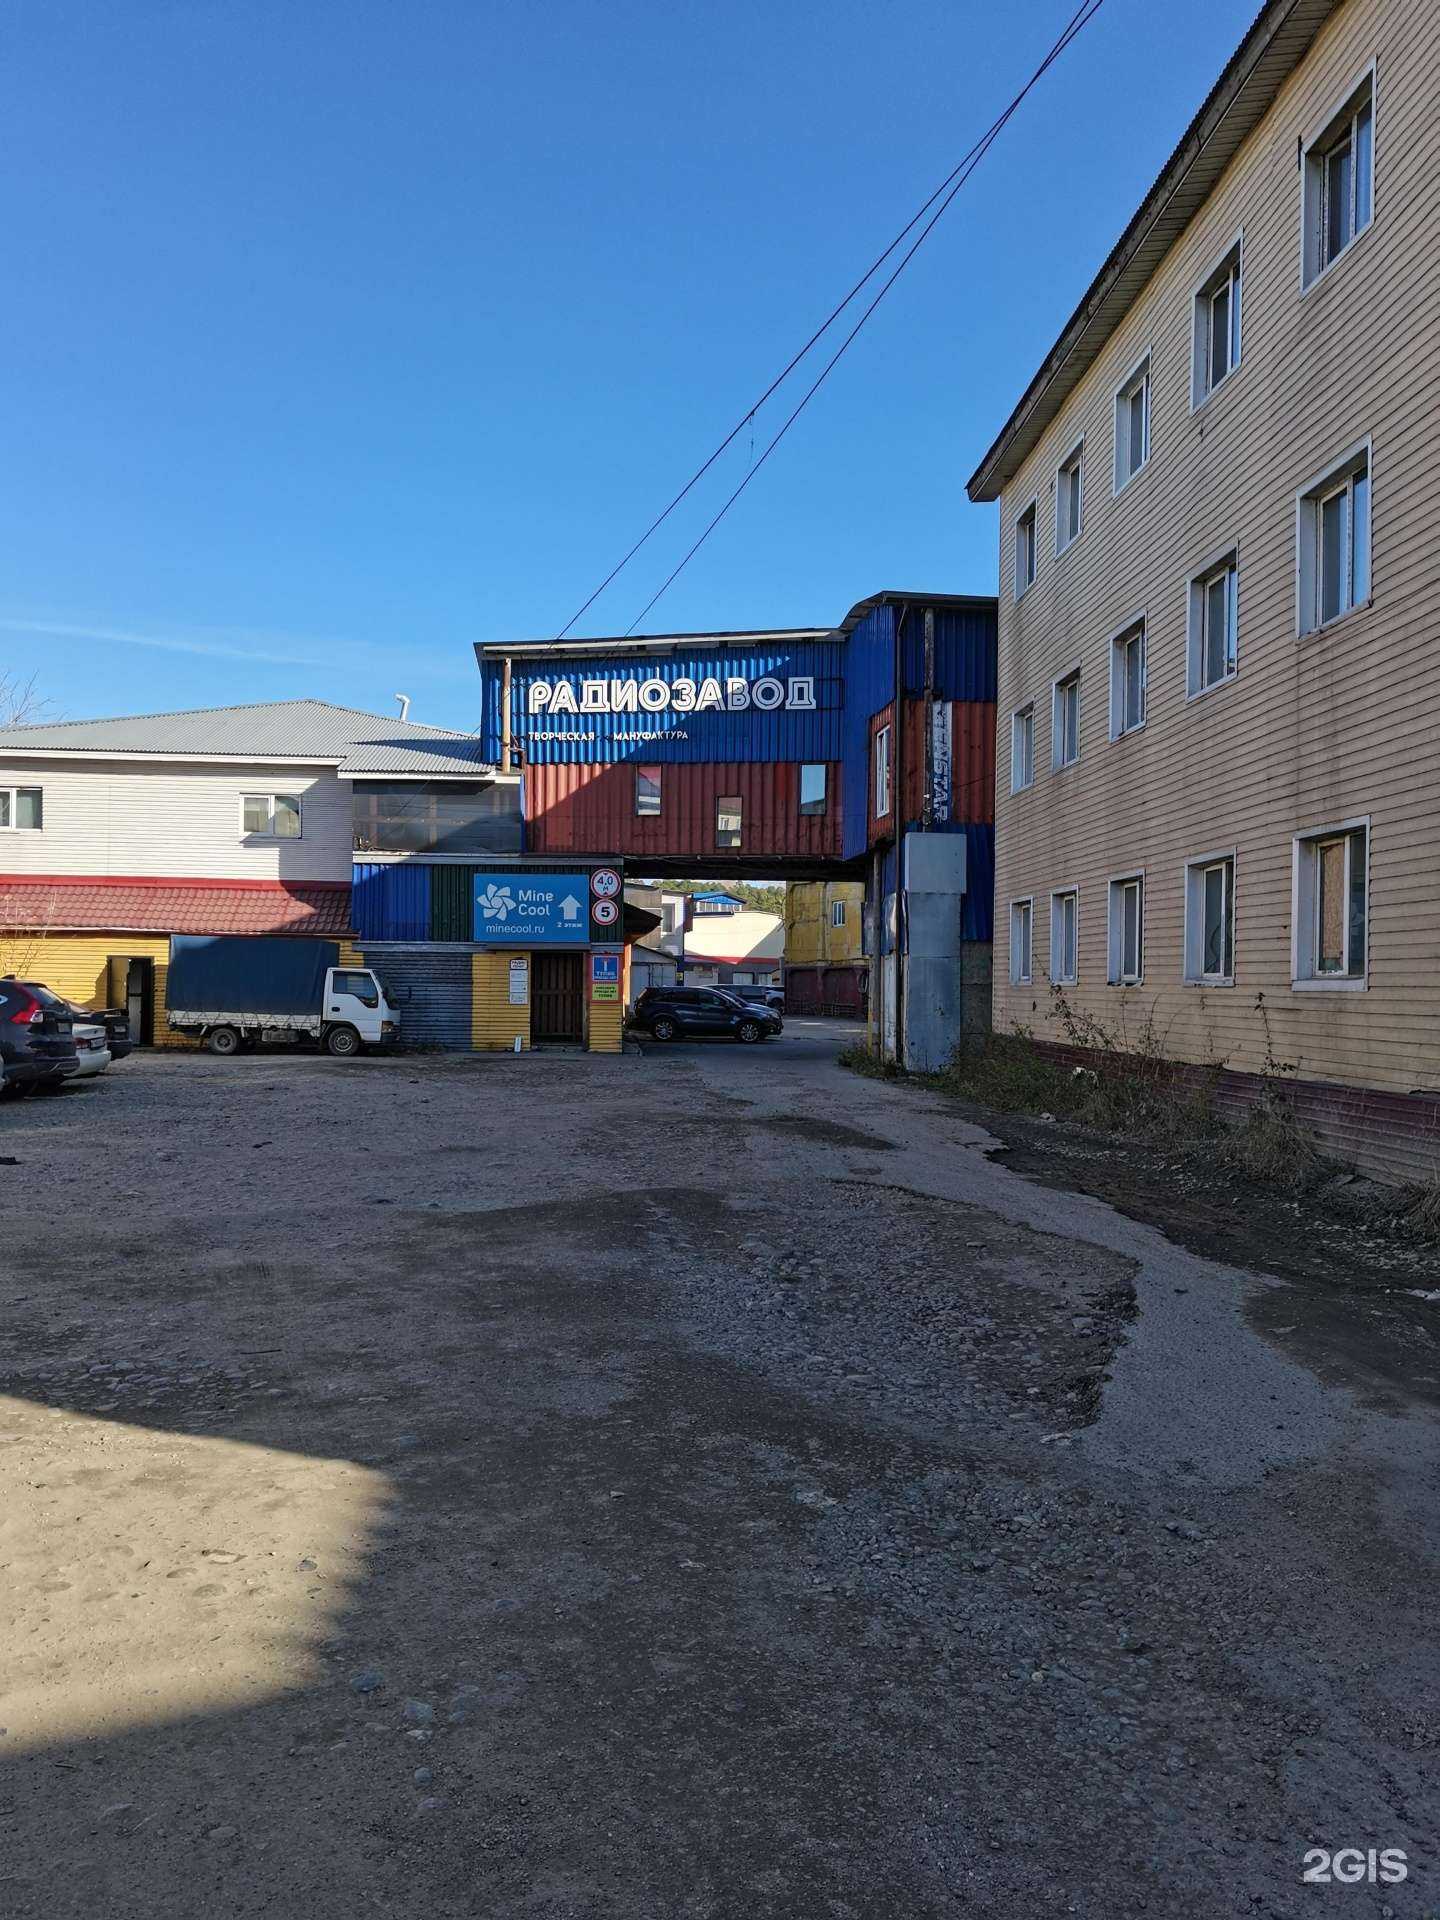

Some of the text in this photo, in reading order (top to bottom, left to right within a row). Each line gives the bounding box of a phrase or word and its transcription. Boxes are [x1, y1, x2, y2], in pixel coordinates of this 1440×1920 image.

[528, 677, 817, 714] РАДИОЗАВОД
[528, 730, 689, 741] ТВОРЧЕСКАЯ МАНУФАКТУРА
[518, 890, 554, 902] Mine
[518, 904, 551, 916] Cool
[601, 906, 611, 918] 5
[486, 923, 545, 934] minecool.ru
